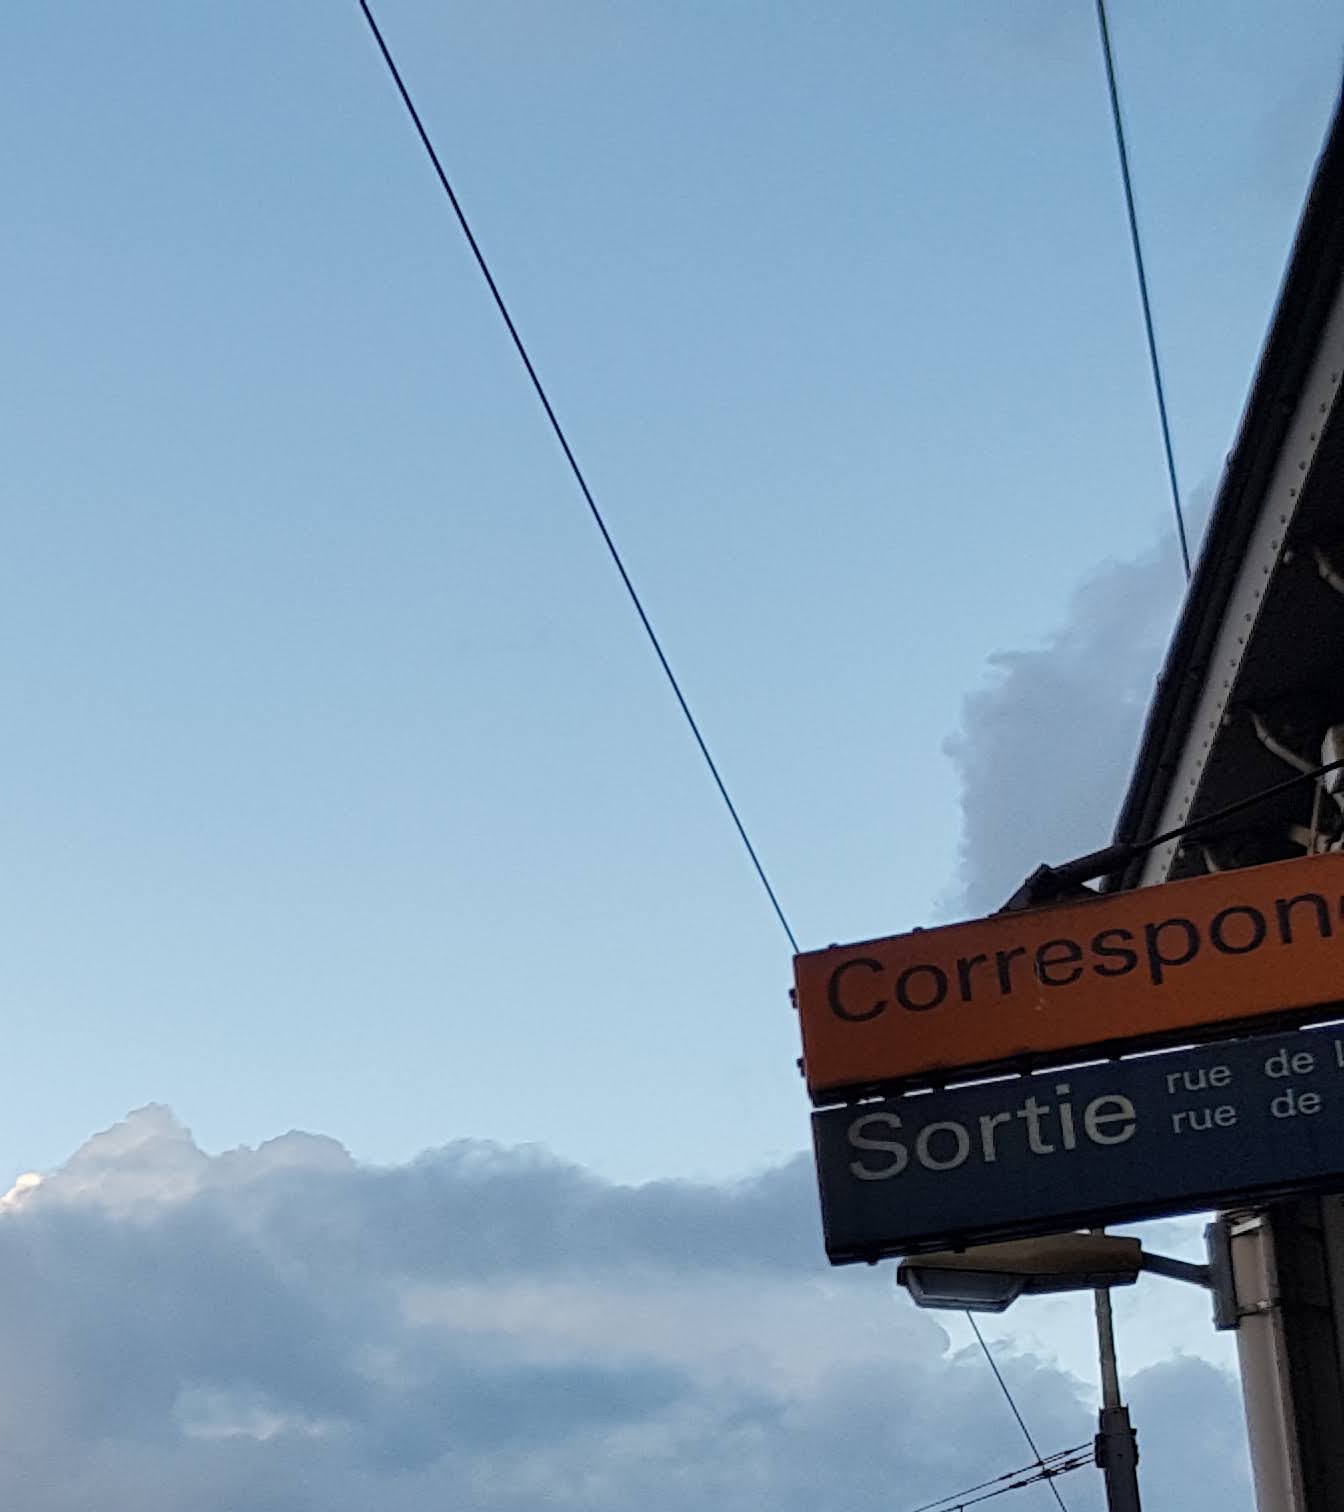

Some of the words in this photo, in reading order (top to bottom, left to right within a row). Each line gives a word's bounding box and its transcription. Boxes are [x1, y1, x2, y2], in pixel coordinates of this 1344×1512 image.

[826, 893, 1344, 1023] Correspon
[1165, 1064, 1233, 1094] rue
[1264, 1048, 1314, 1078] de
[847, 1083, 1136, 1181] Sortie
[1171, 1103, 1238, 1134] rue
[1270, 1088, 1322, 1118] de
